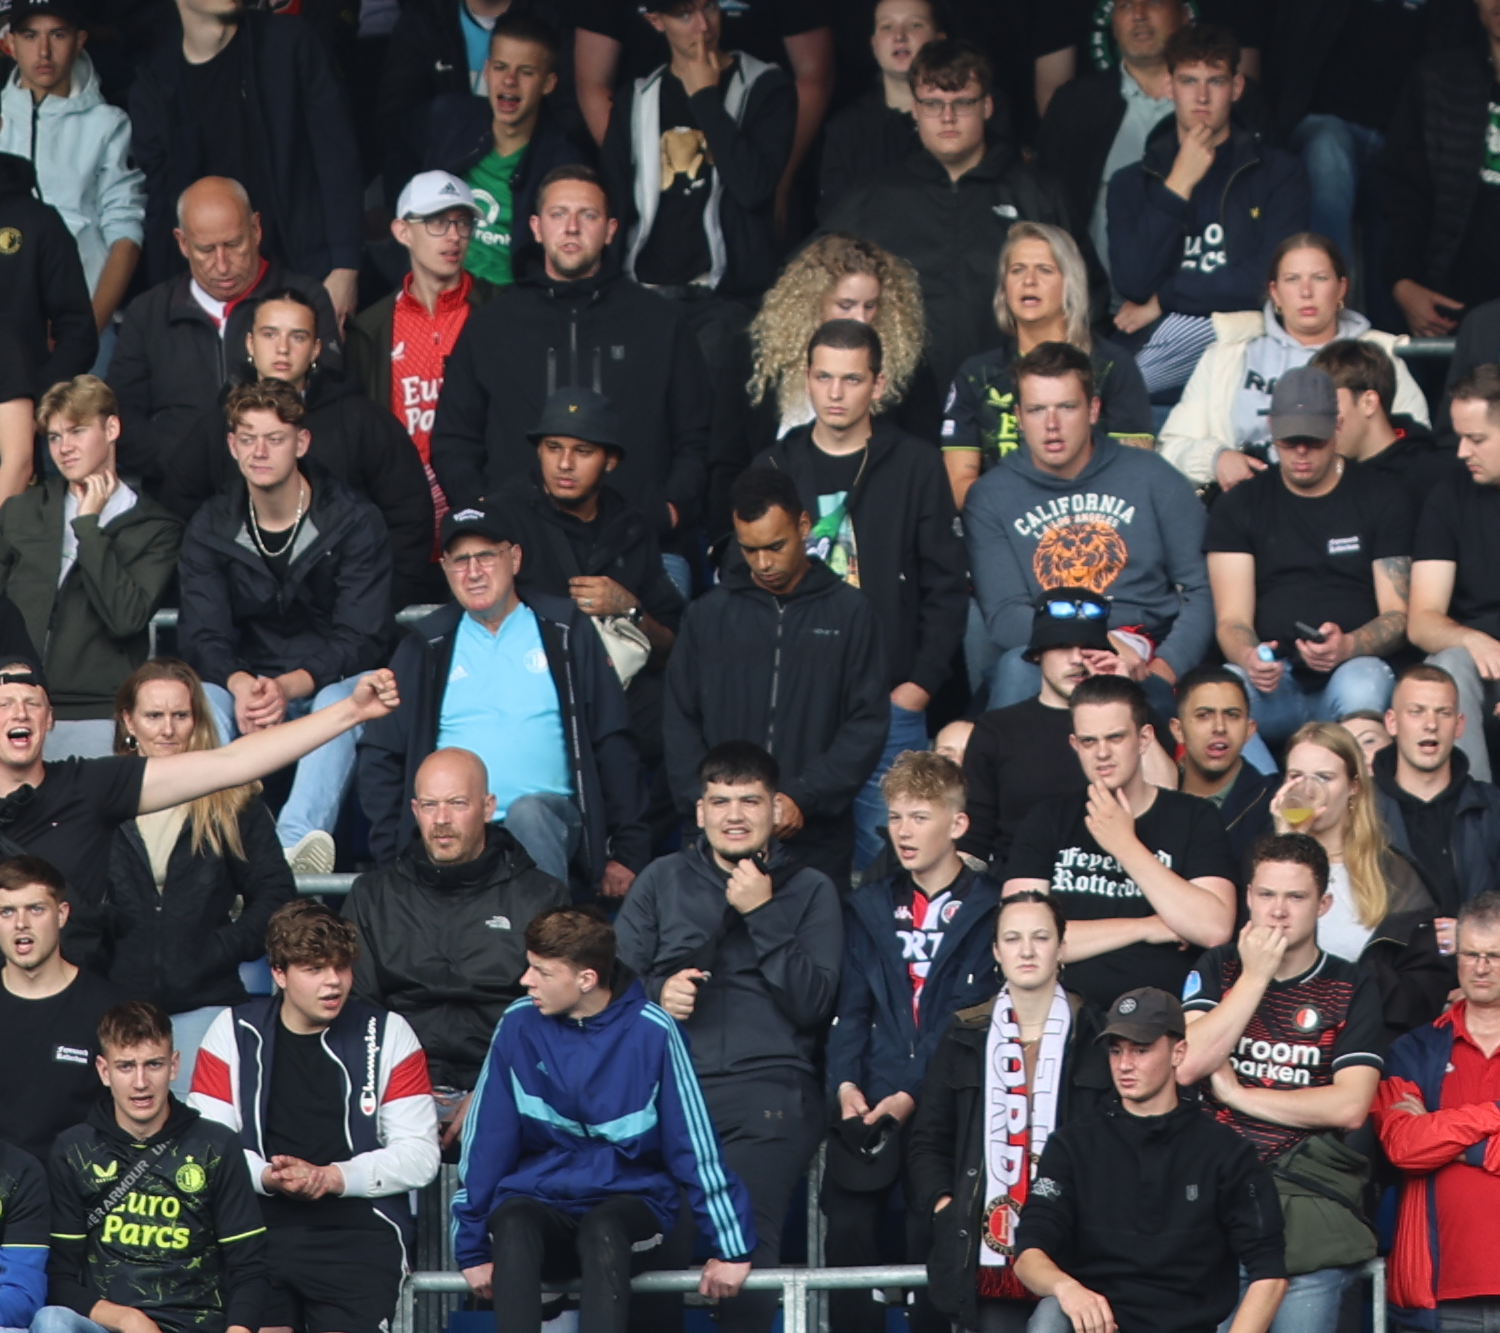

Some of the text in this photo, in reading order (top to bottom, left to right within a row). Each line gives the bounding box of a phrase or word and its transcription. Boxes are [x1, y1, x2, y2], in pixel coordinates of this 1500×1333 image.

[1013, 492, 1137, 537] CALIFORNIA
[359, 1015, 378, 1117] Champion
[1232, 1035, 1322, 1068] room
[100, 1213, 192, 1250] Parcs
